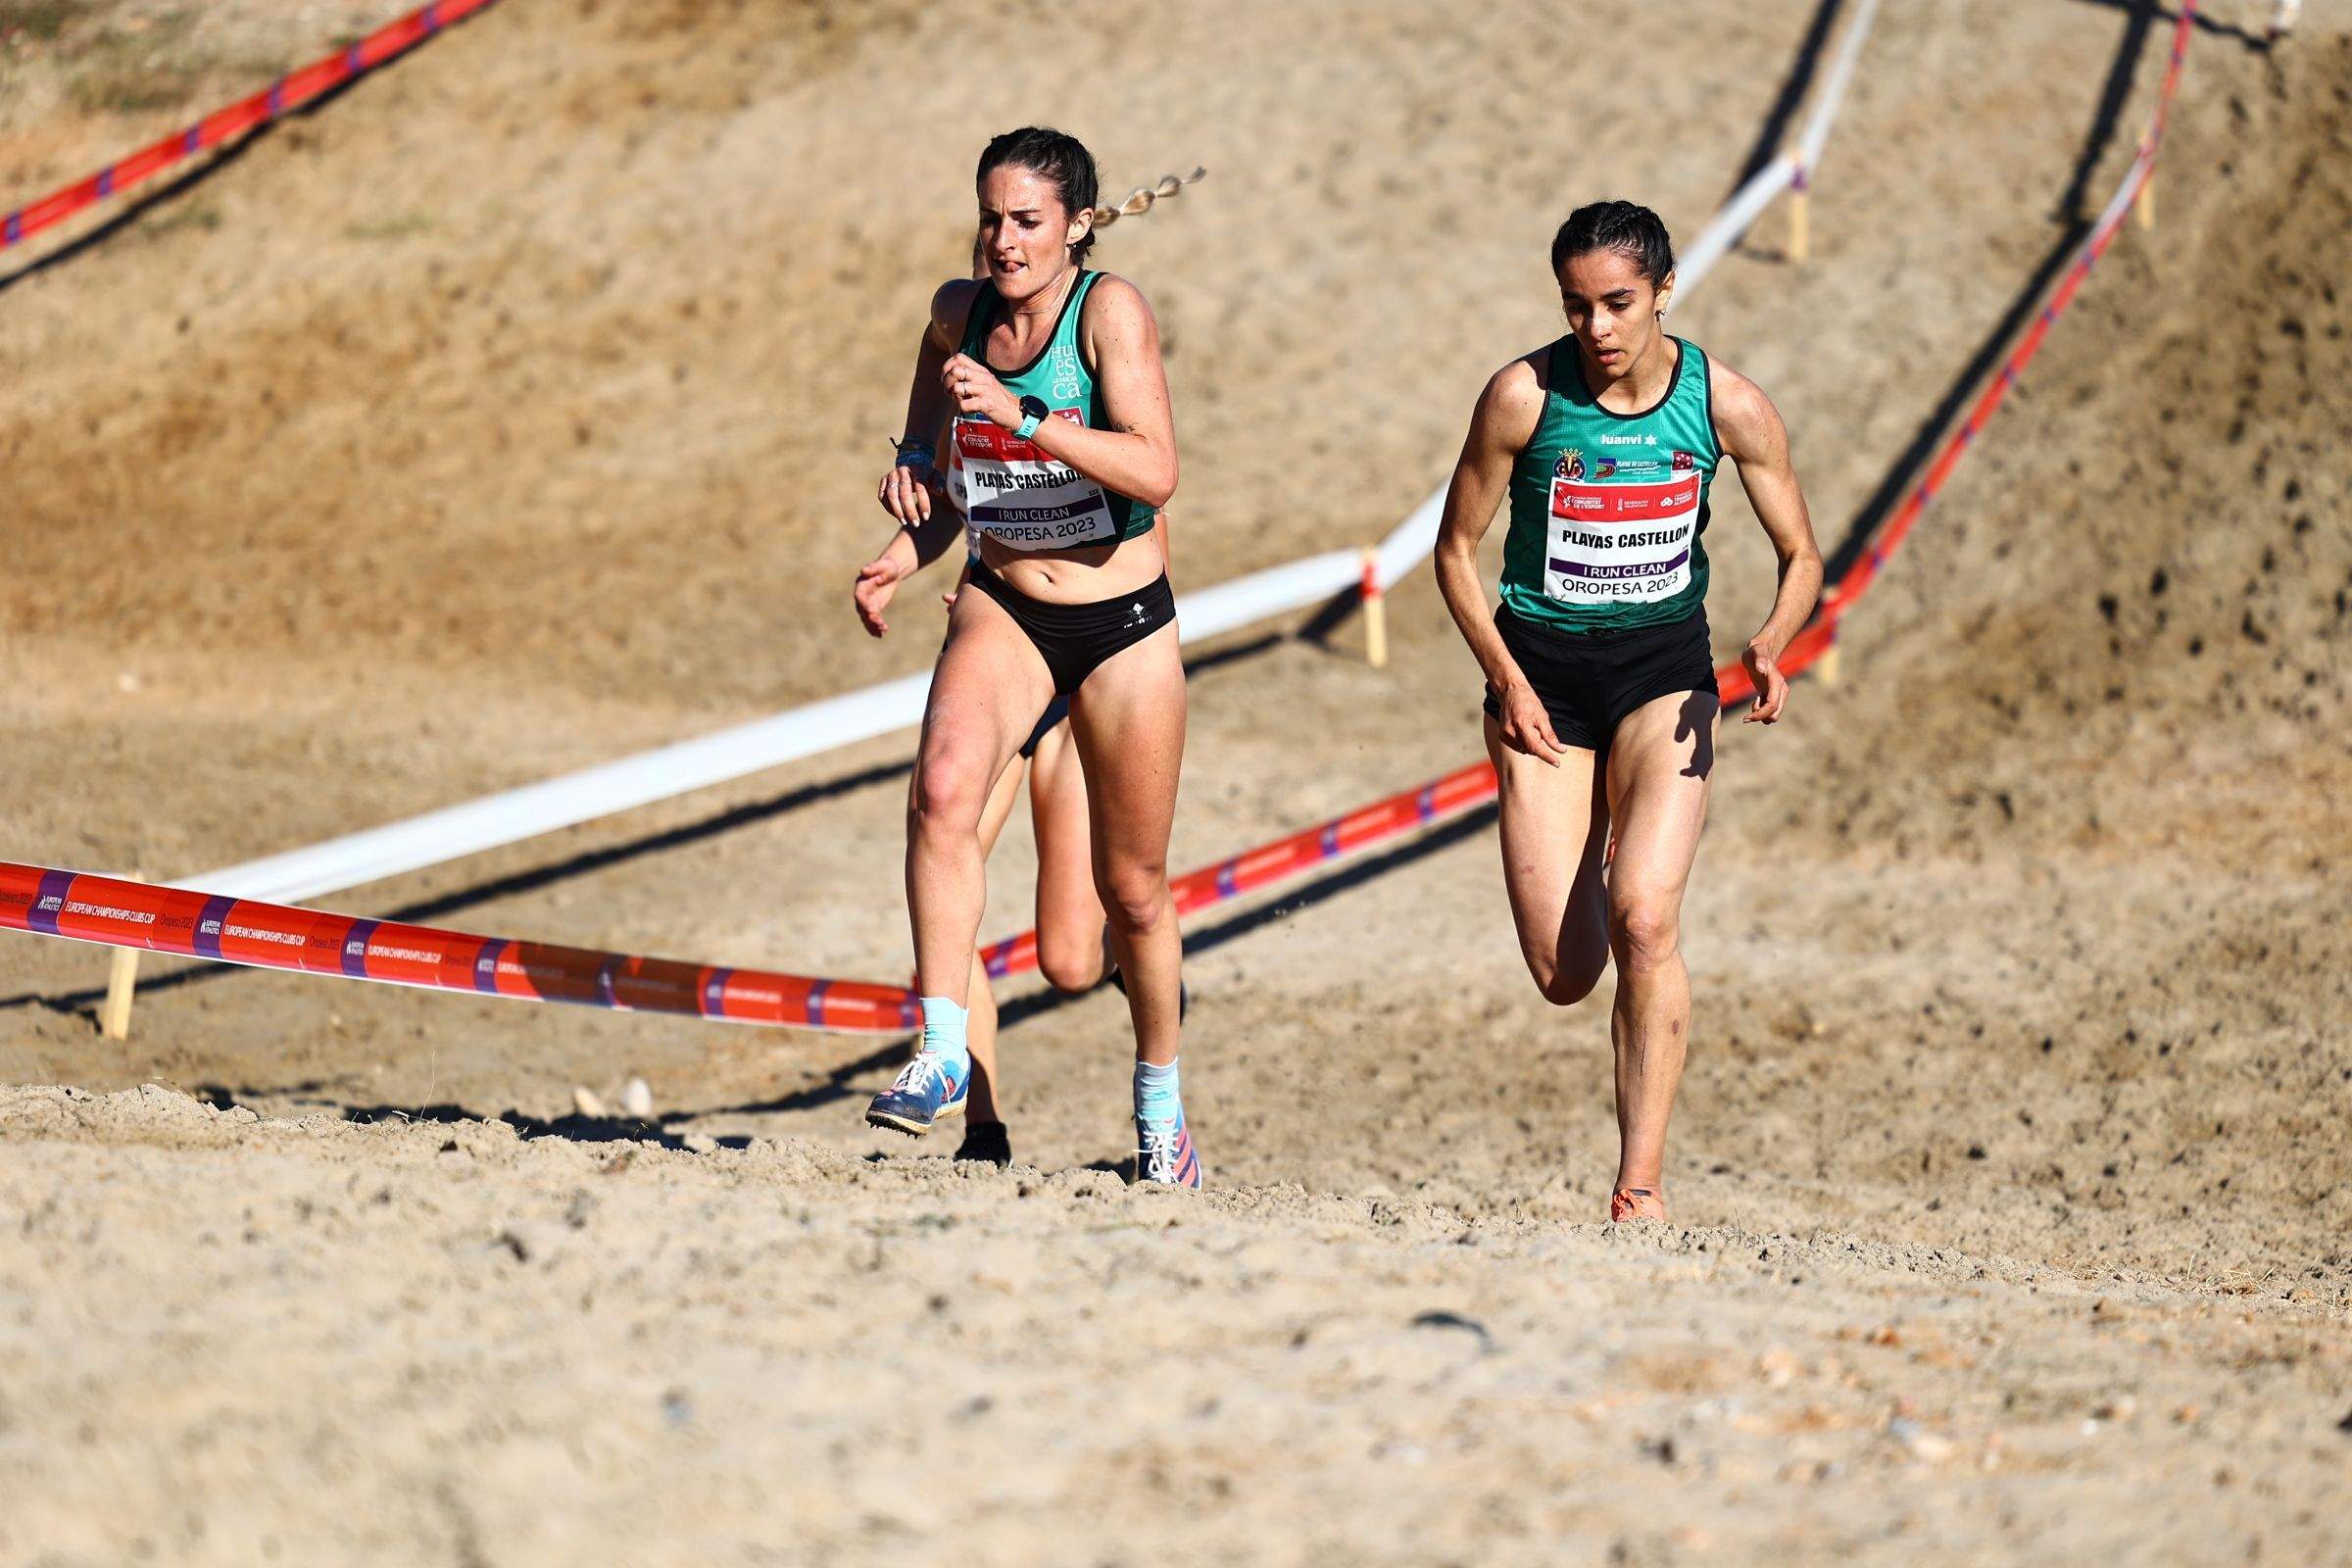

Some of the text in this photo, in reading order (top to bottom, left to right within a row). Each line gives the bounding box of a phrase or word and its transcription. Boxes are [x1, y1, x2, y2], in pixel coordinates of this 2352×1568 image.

[1601, 433, 1642, 445] luanvi
[975, 471, 1013, 489] PLAYAS
[998, 507, 1070, 521] I RUN CLEAN
[1056, 516, 1097, 538] 2023
[1562, 523, 1690, 549] PLAYAS CASTELLON
[1584, 563, 1667, 578] I RUN CLEAN
[1562, 571, 1679, 595] OROPESA 2023
[65, 901, 156, 925] EUROPEAN CHAMPIONSHIPS CLUBS CUP
[224, 924, 249, 938] EUROPEAN
